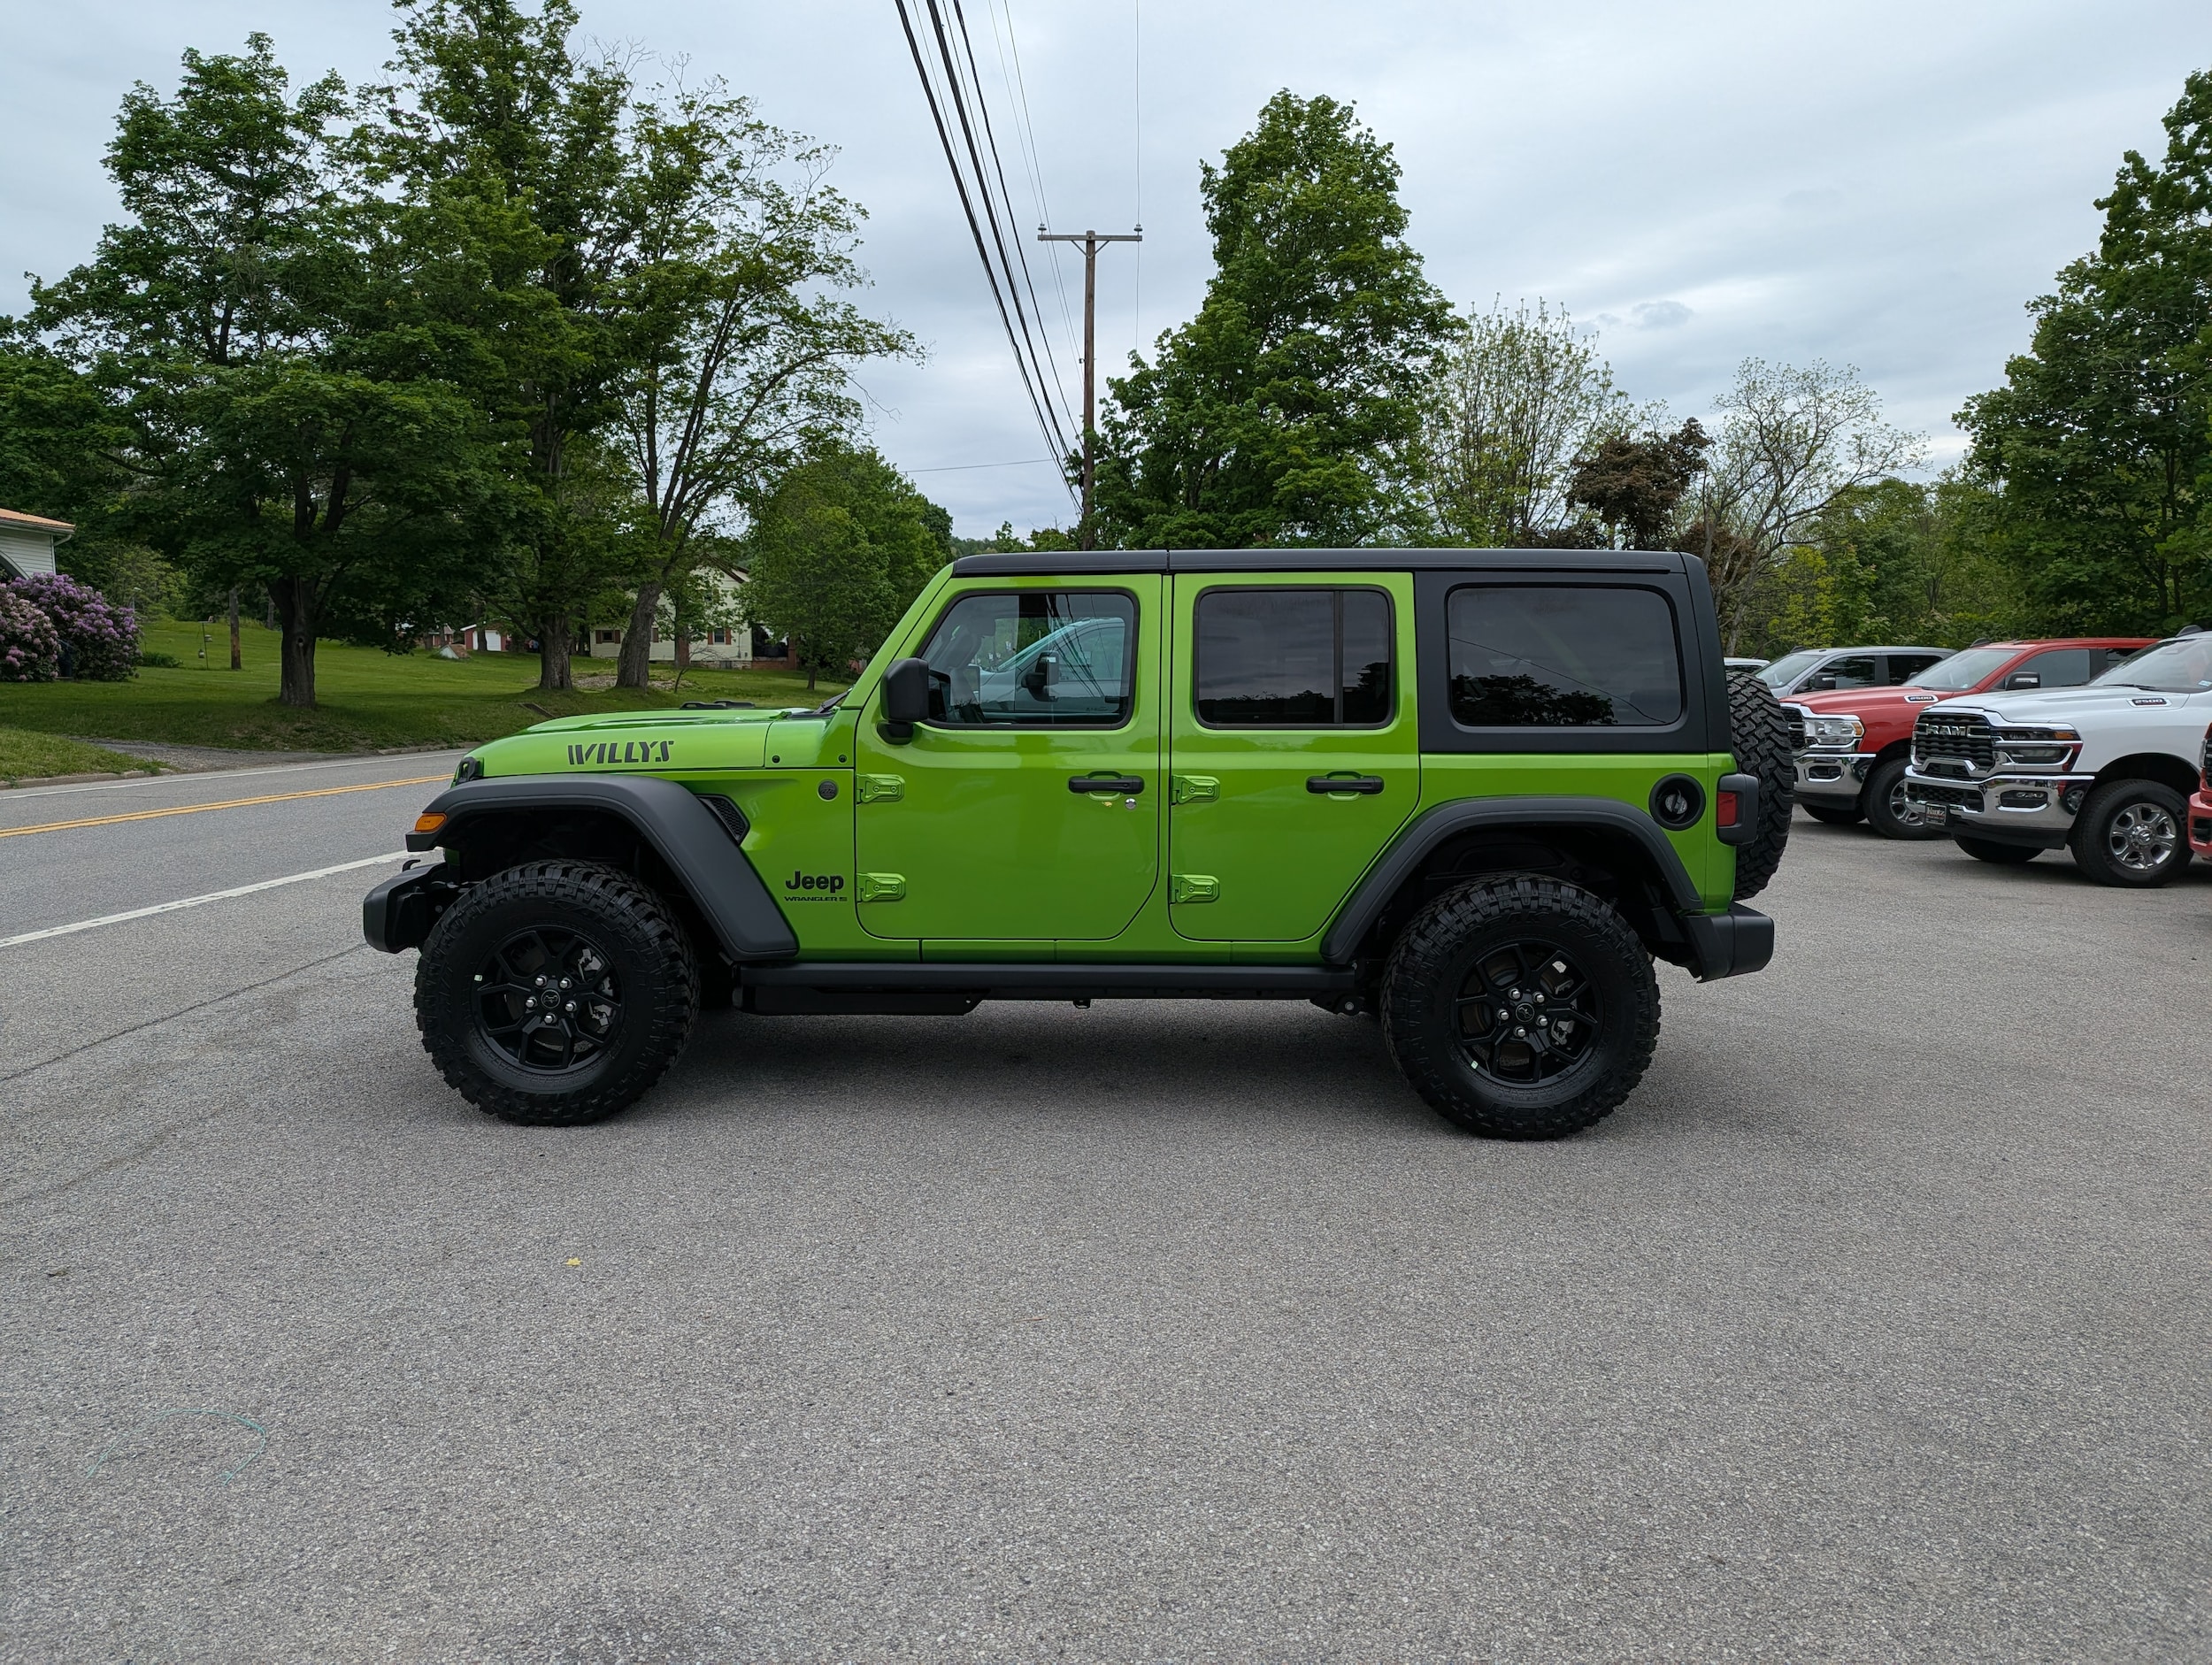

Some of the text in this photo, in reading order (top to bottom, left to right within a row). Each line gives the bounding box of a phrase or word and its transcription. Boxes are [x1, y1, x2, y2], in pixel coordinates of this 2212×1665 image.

[1925, 725, 1966, 737] RAM
[567, 740, 674, 765] WILLYS
[786, 871, 844, 894] Jeep
